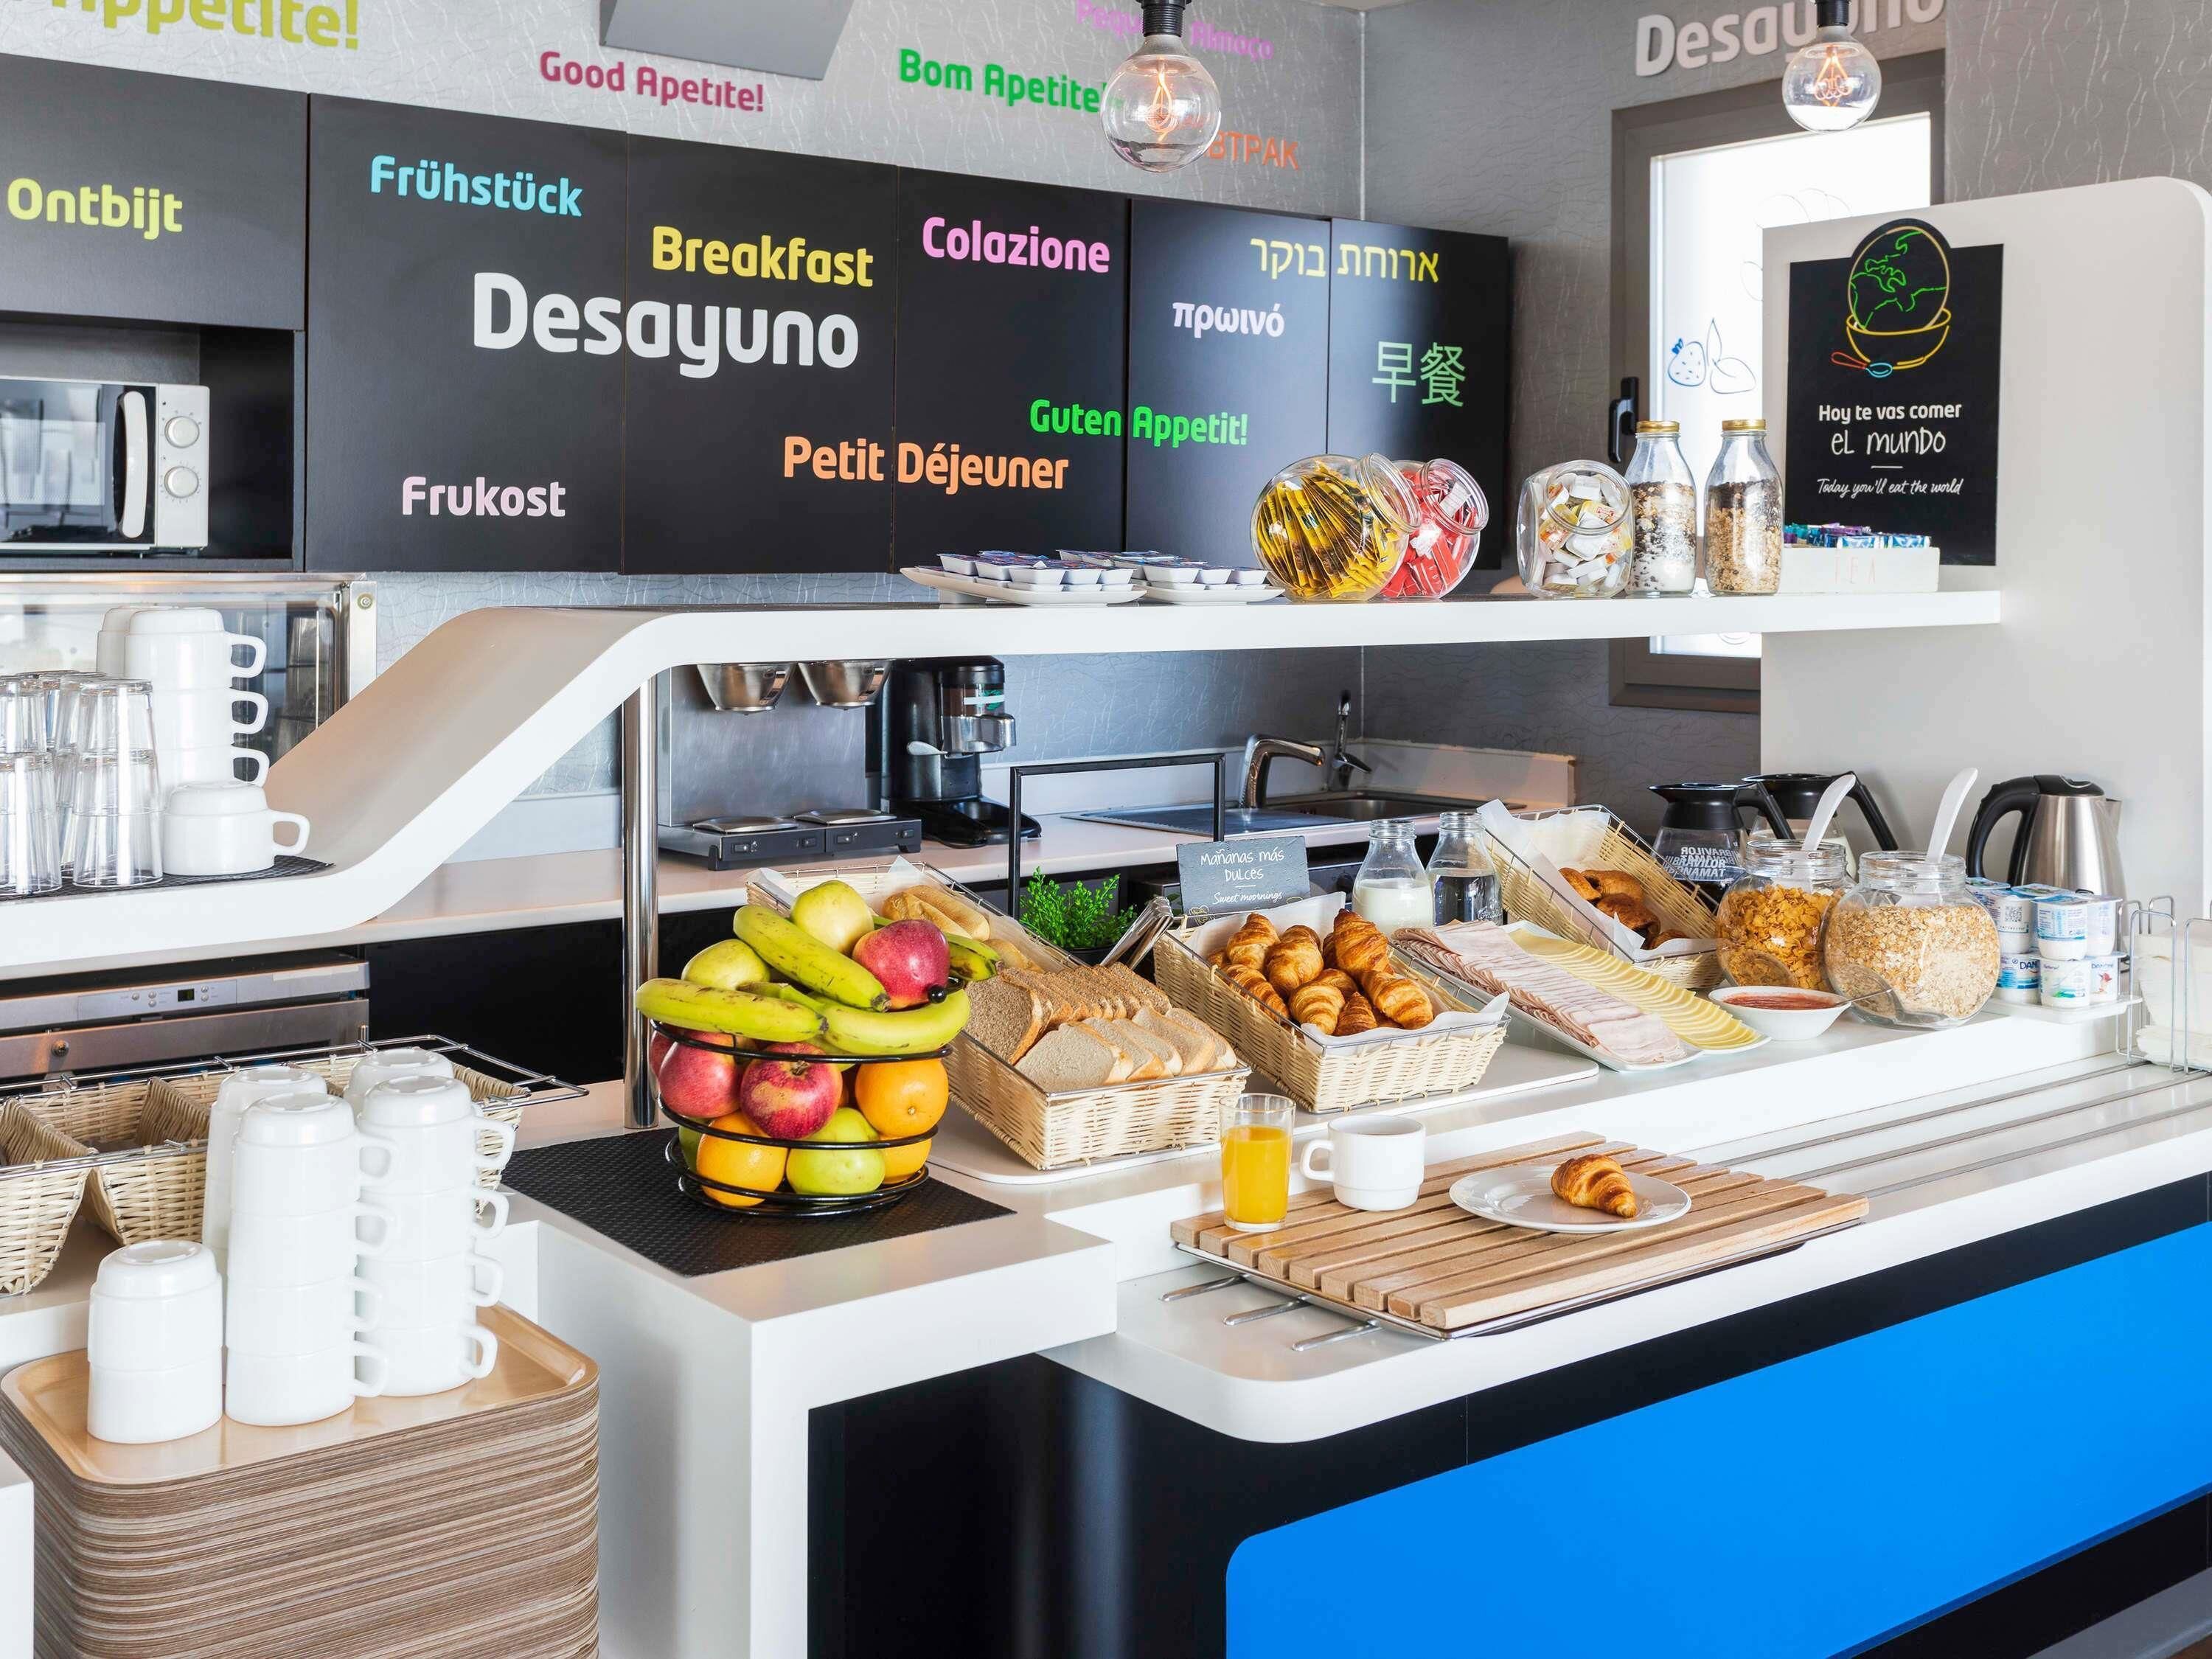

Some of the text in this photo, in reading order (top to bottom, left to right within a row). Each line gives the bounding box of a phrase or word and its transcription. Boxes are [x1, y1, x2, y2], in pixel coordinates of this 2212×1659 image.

[52, 0, 359, 49] ppetite!
[540, 51, 764, 112] Good Apetite!
[899, 48, 973, 92] Bom
[7, 178, 183, 240] Ontbijt
[370, 155, 584, 218] Frühstück
[652, 226, 874, 288] Breakfast
[922, 217, 1110, 273] Colazione
[1250, 237, 1440, 283] ארוחת בוקר
[473, 272, 859, 379] Desayuno
[1172, 302, 1285, 338] πρωινό
[1371, 341, 1467, 407] 早餐
[1029, 398, 1248, 449] Guten Appetit!
[1818, 403, 1962, 425] Hoy te vas comer
[784, 436, 1070, 495] Petit Déjeuner
[1817, 478, 1964, 499] Today you'll eat the world
[401, 476, 567, 518] Frukost
[1200, 846, 1285, 866] Mañanas más
[1212, 891, 1240, 905] Sweet
